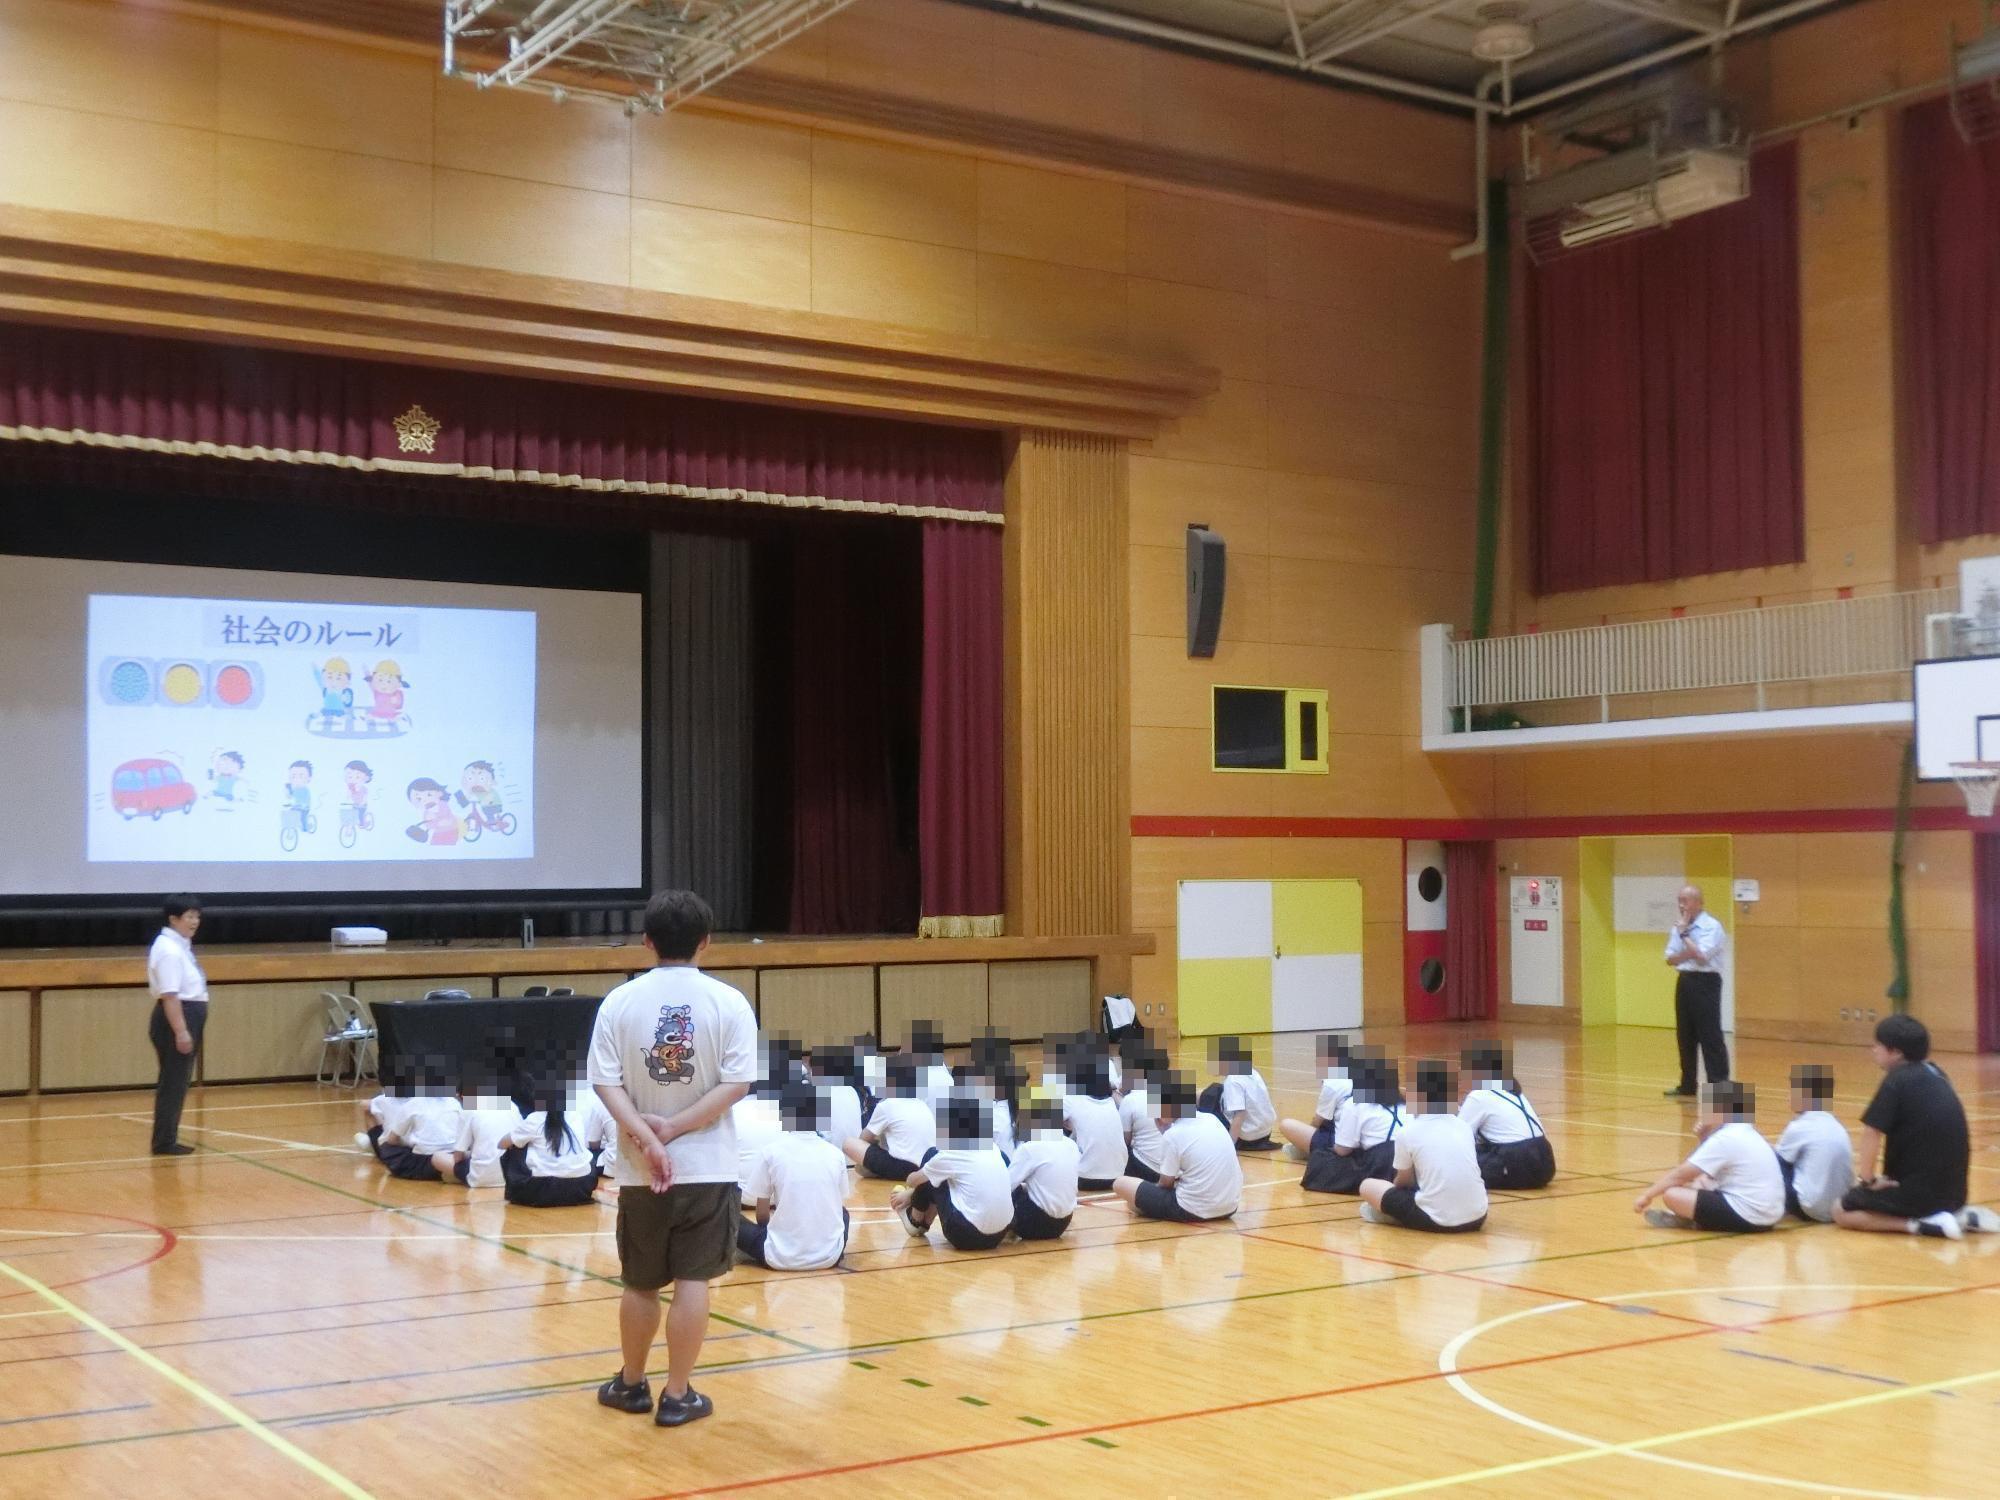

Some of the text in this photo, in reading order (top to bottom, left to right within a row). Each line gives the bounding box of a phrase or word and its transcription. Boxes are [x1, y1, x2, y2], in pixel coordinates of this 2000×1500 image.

[222, 615, 402, 647] 社会のルール
